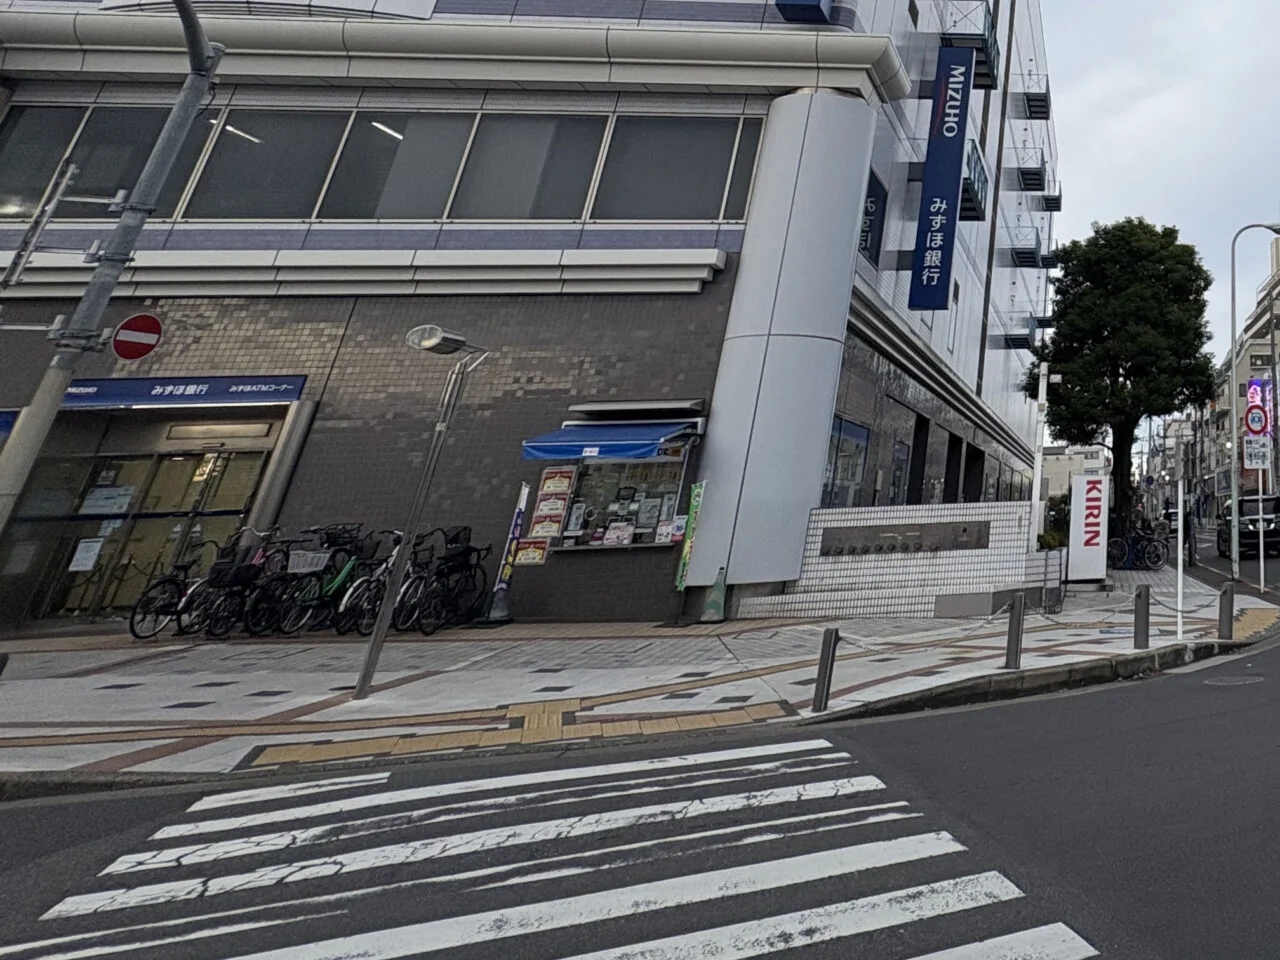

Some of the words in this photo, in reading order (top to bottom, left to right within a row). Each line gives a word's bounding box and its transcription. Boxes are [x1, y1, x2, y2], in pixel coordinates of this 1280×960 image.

[943, 64, 966, 138] MIZUHO
[921, 197, 948, 286] みずほ銀行
[151, 384, 209, 396] みずほ銀行
[1083, 479, 1102, 547] KIRIN
